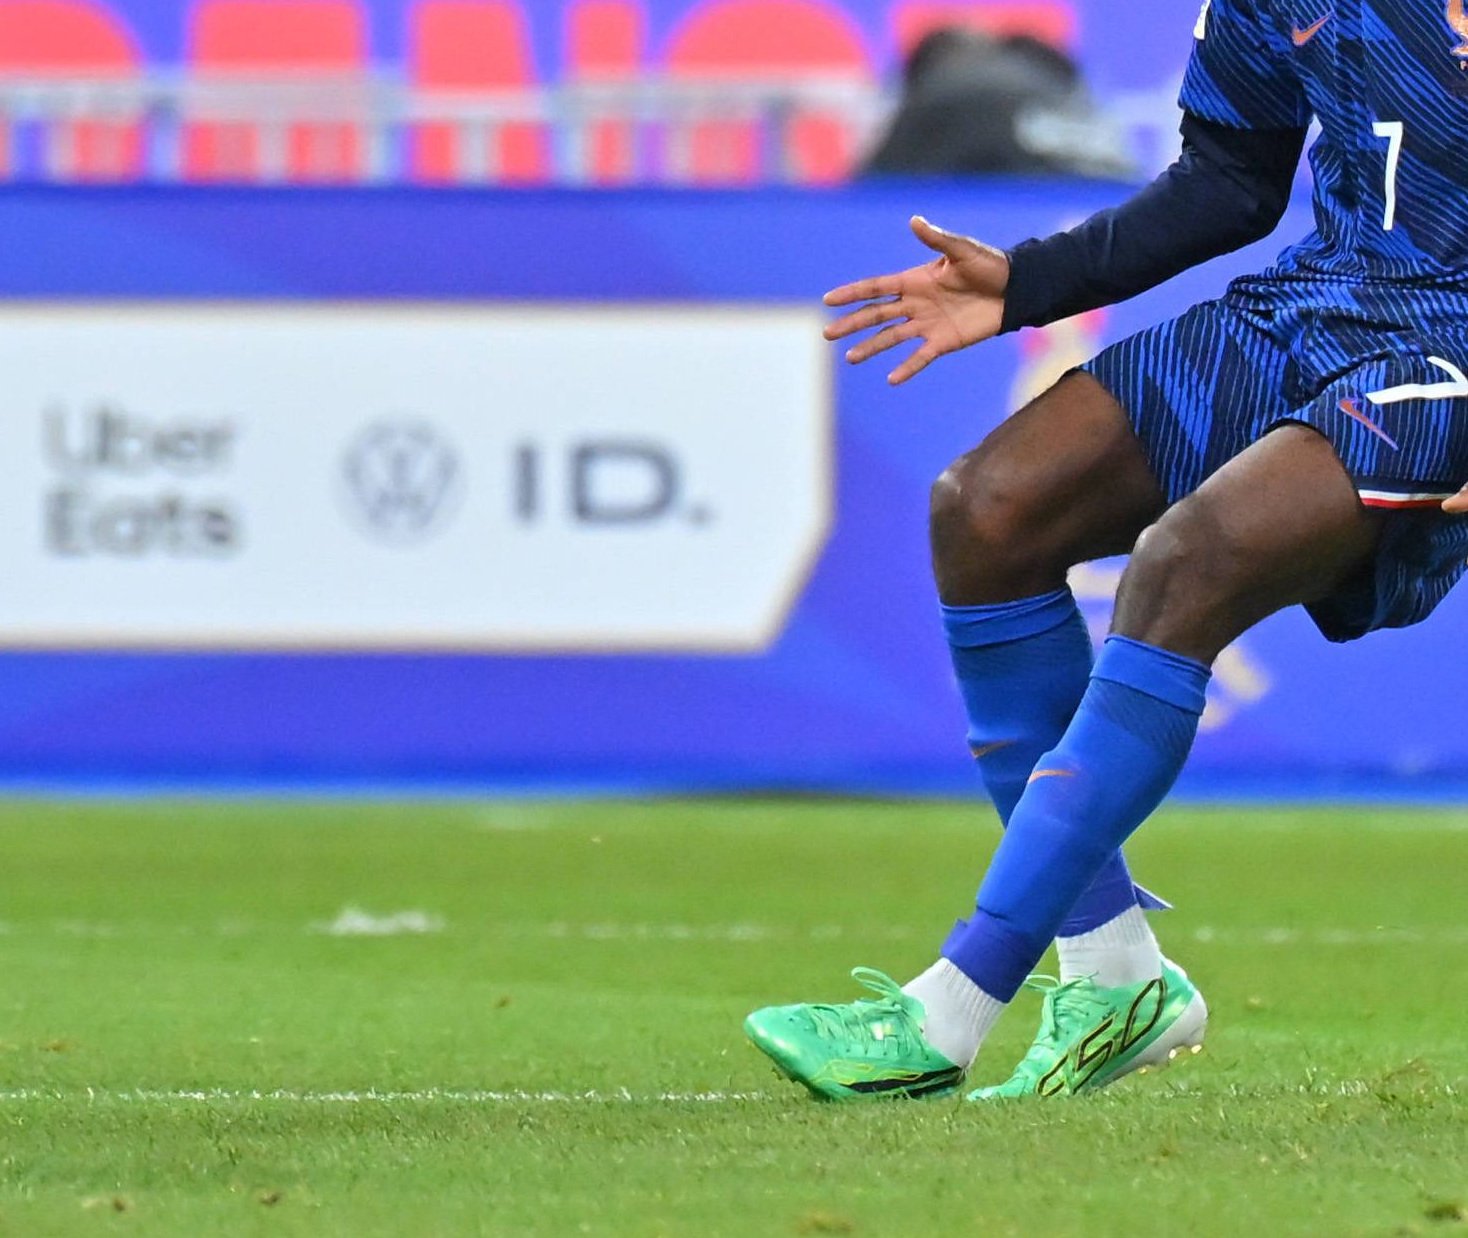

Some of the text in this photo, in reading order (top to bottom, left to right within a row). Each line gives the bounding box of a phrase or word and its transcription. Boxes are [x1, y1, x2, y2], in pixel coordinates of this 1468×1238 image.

[1372, 120, 1404, 231] 7
[41, 402, 237, 472] Uber
[43, 490, 244, 559] Eats
